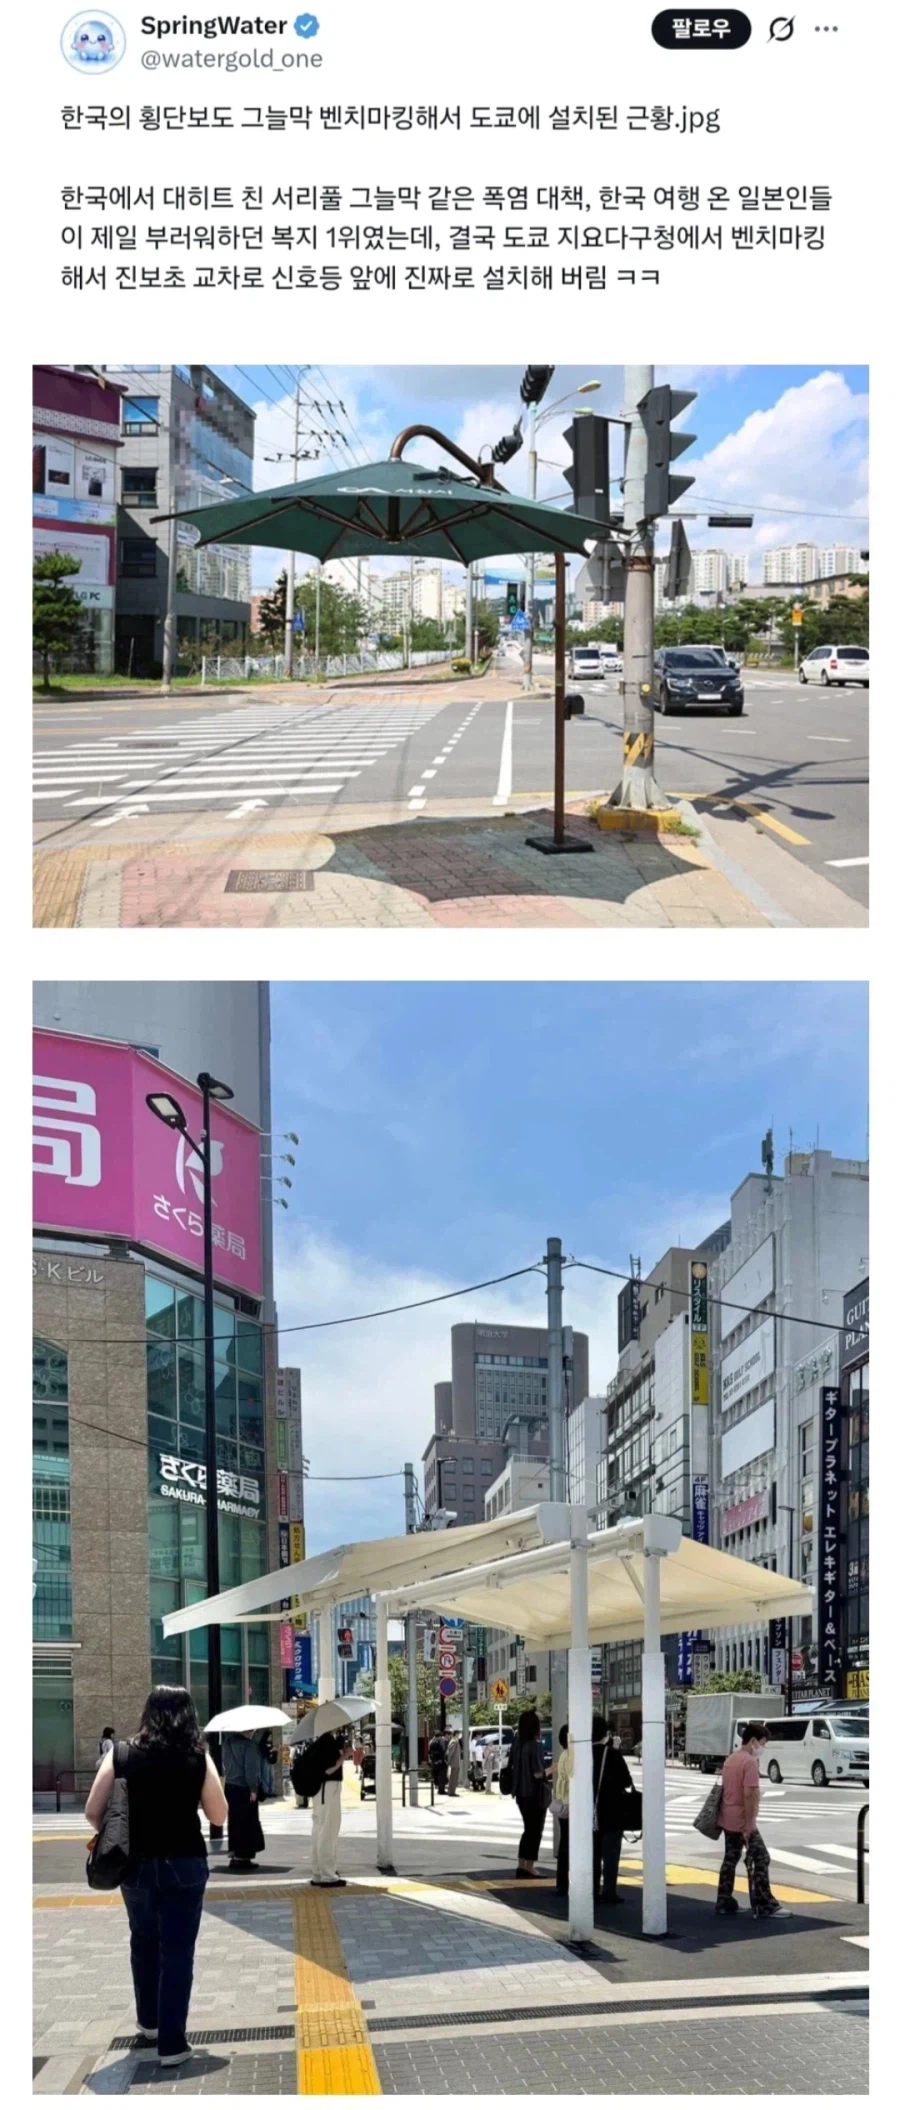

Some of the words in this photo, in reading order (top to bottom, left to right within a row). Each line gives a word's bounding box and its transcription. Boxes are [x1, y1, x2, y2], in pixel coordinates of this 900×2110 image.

[89, 591, 100, 601] PC
[824, 1391, 838, 1520] ギタープラネット
[823, 1527, 838, 1683] エレキギター&ベース
